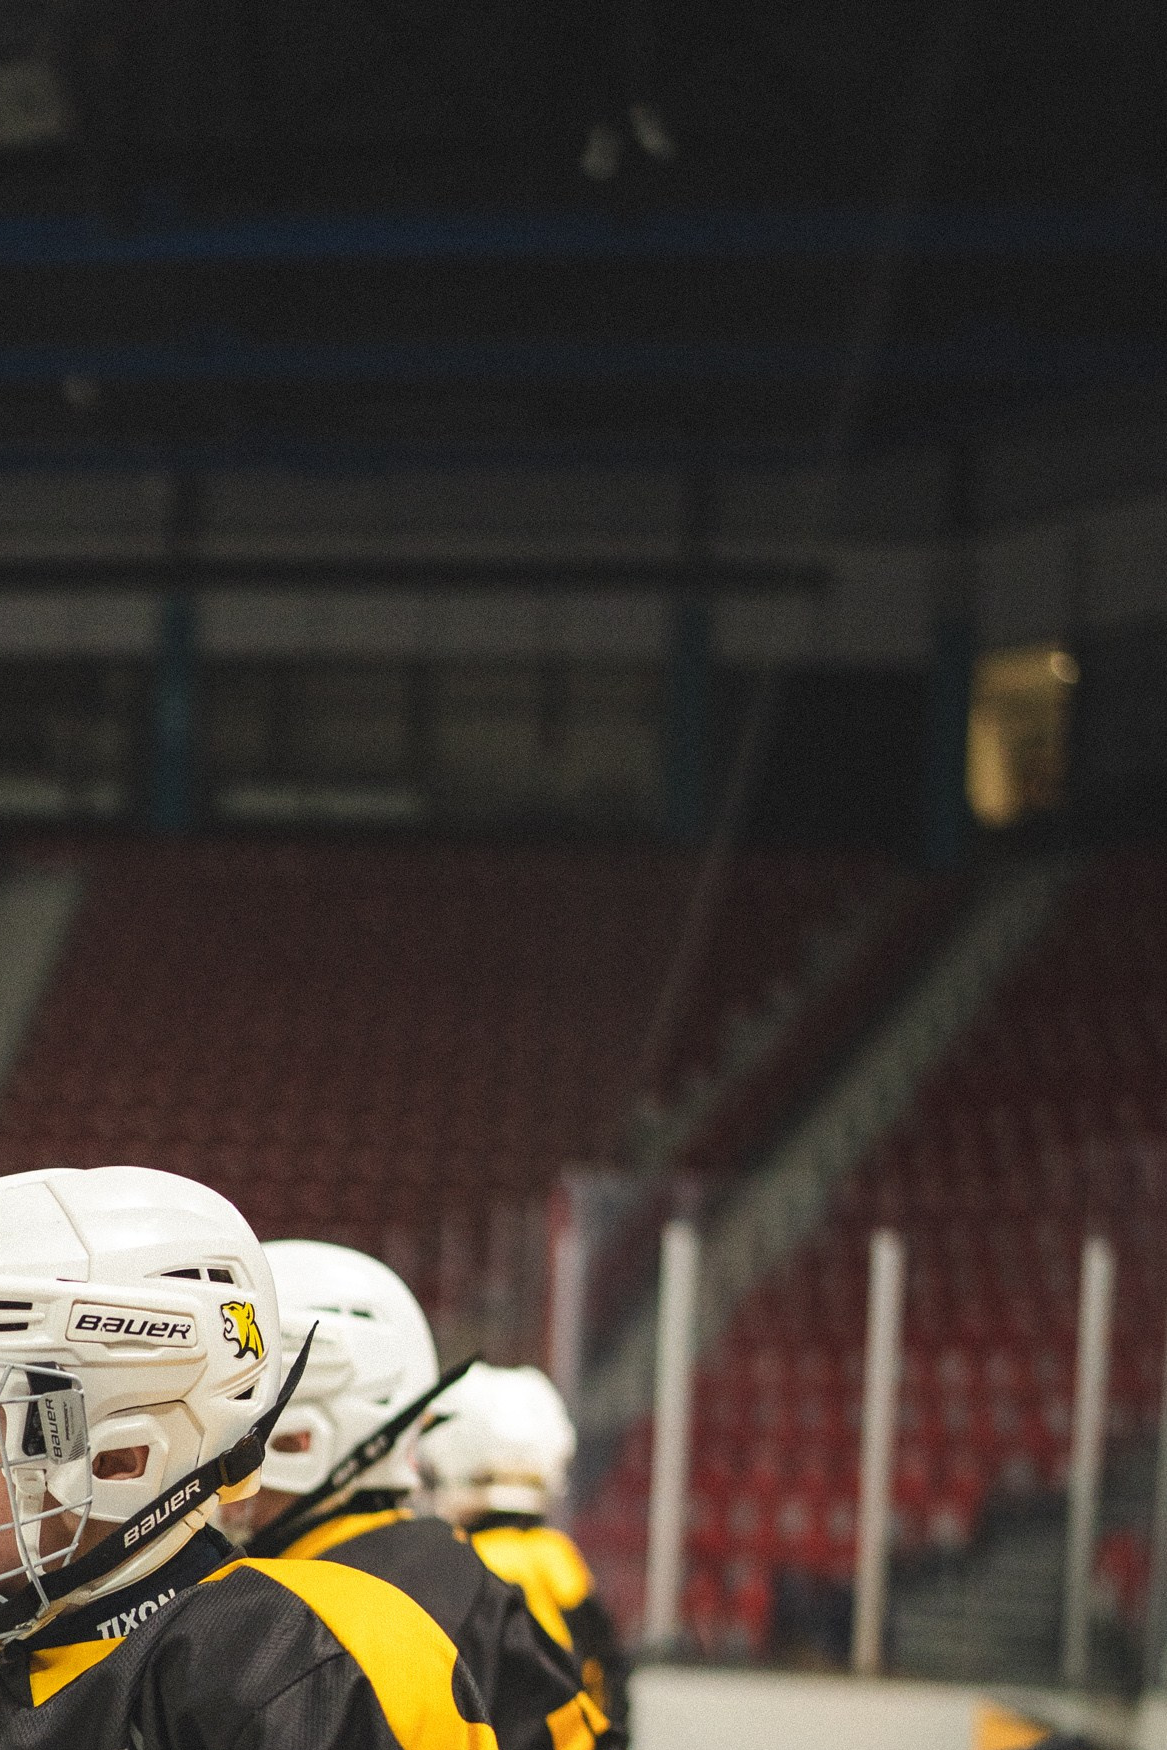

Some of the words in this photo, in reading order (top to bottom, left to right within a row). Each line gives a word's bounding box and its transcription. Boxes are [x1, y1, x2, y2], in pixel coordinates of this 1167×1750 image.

[74, 1313, 192, 1341] BAUER
[45, 1398, 63, 1459] BAUER
[123, 1479, 203, 1549] BAUER
